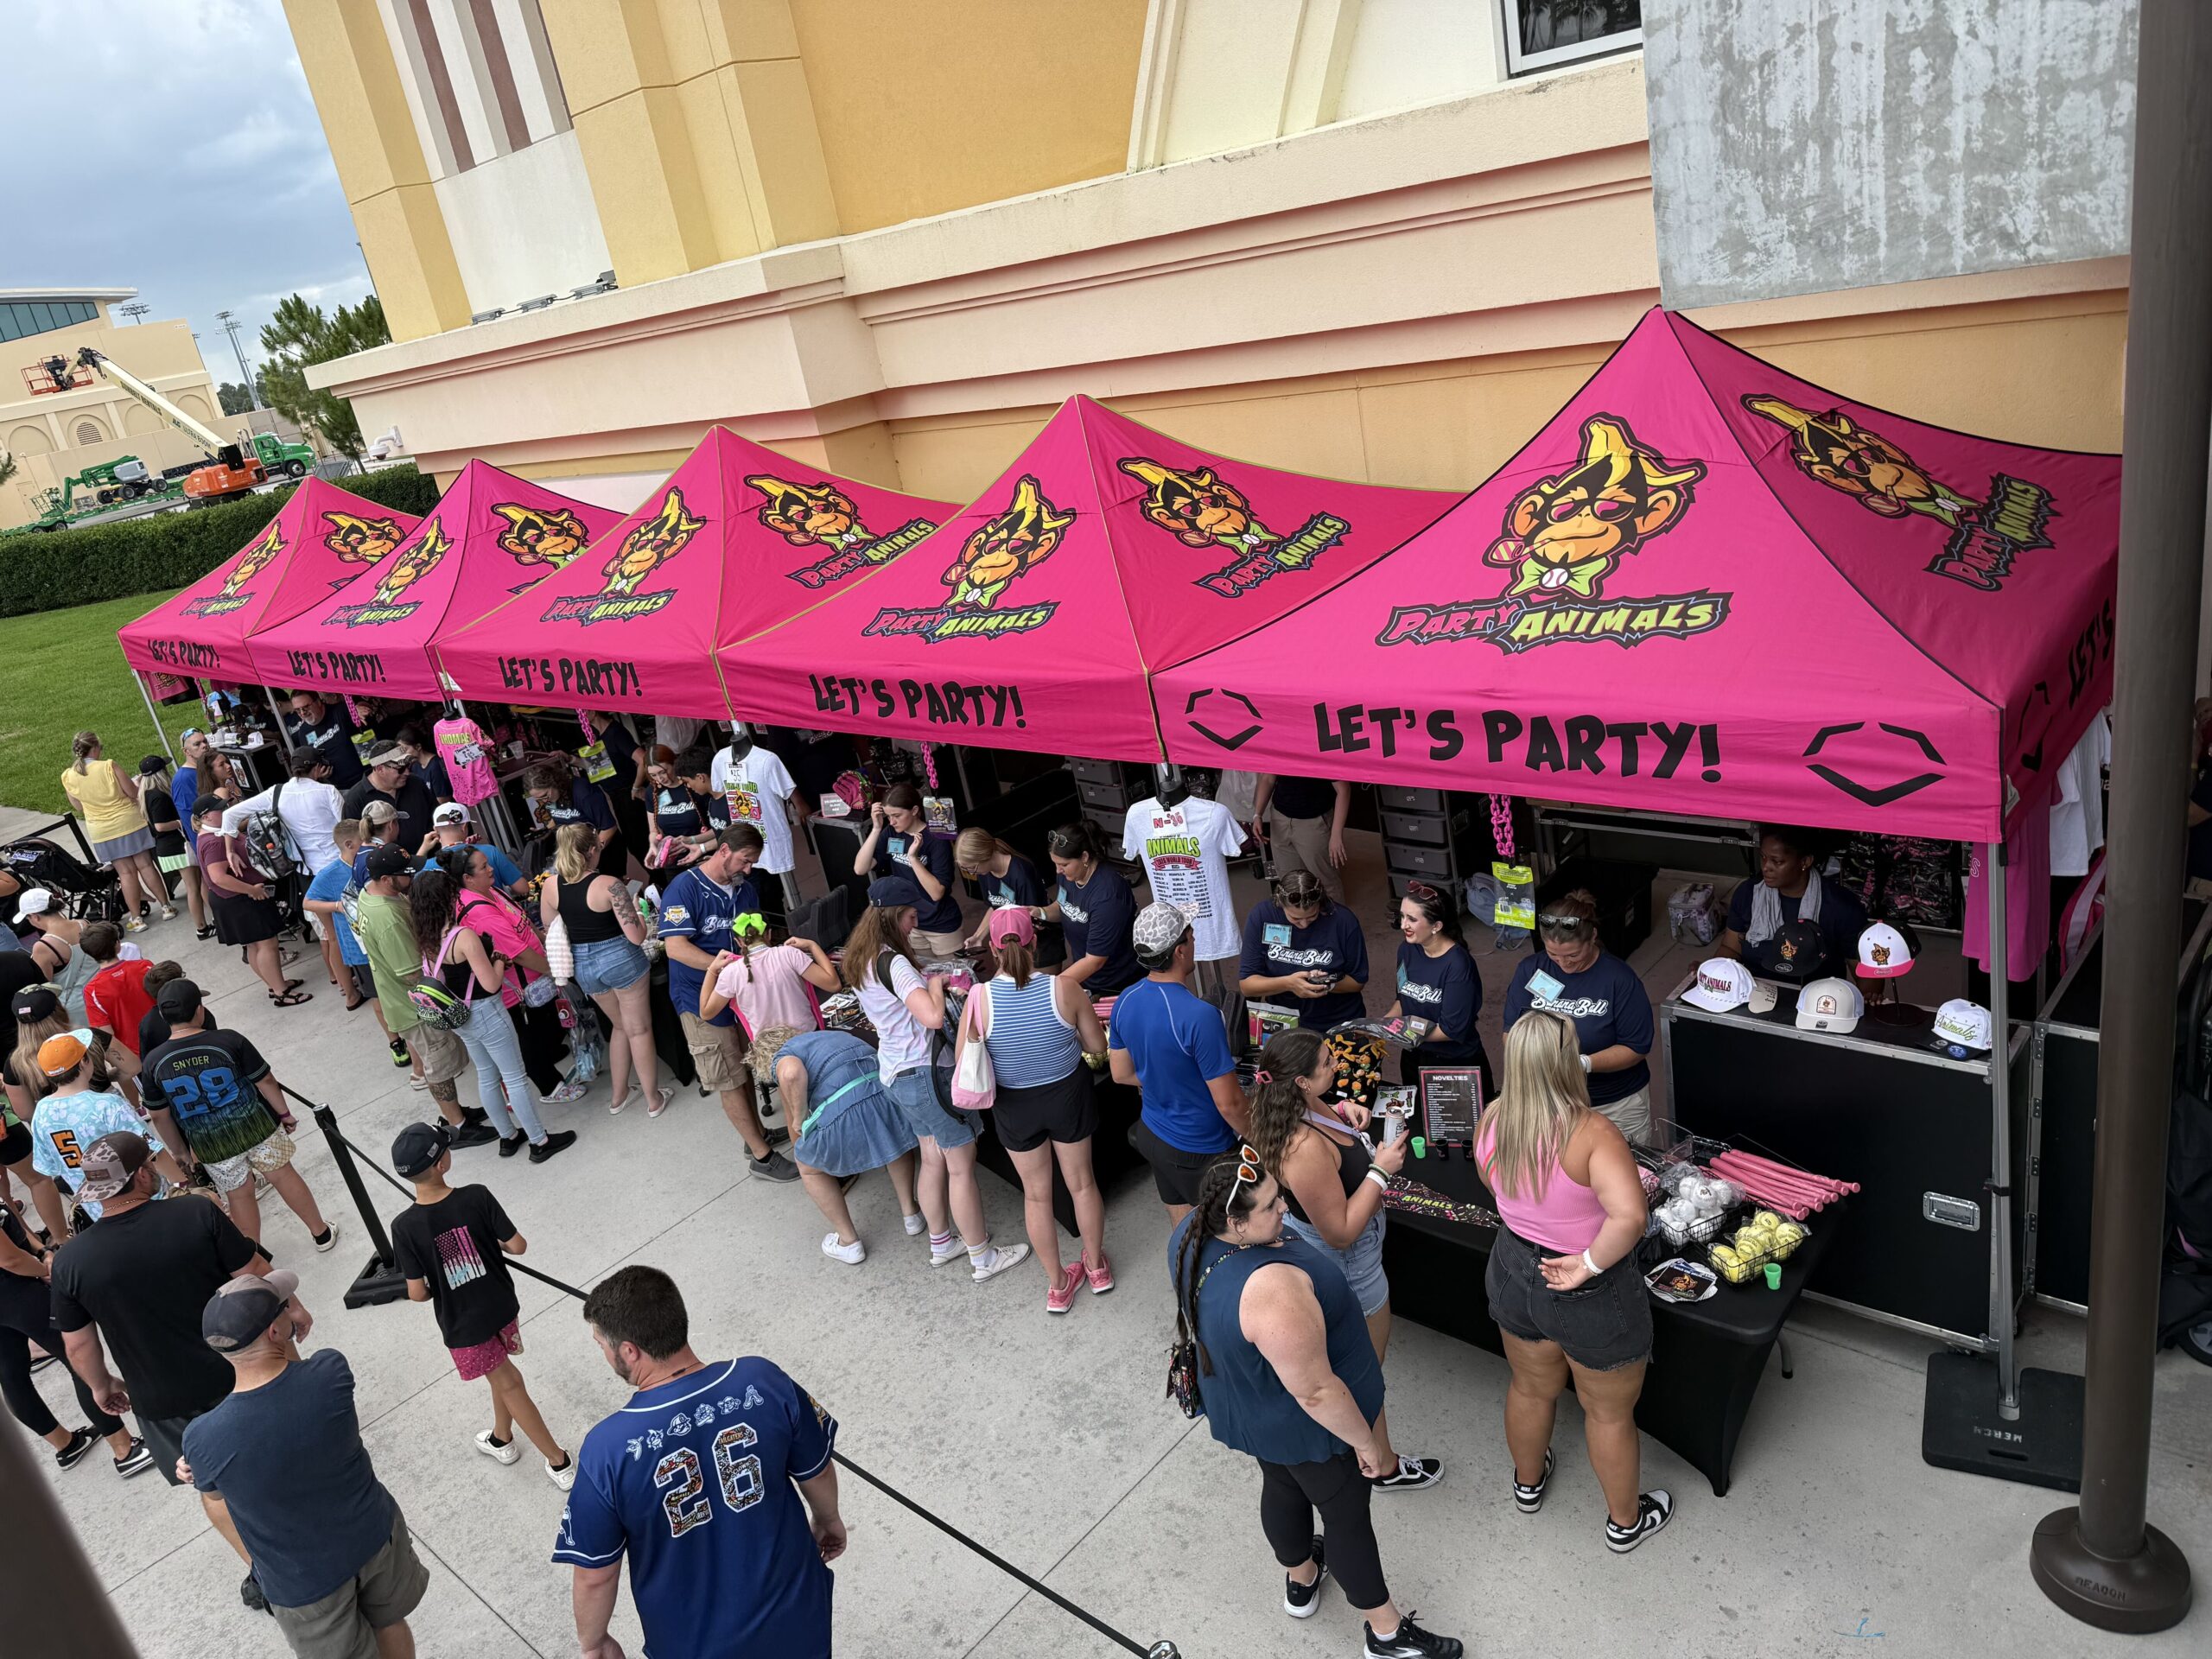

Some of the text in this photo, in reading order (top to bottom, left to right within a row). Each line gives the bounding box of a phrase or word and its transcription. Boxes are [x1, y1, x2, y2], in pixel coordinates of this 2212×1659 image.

[805, 520, 936, 586] PARTY ANIMALS
[1218, 516, 1344, 595] PARTY ANIMALS
[545, 594, 668, 620] PARTY ANIMALS
[1391, 599, 1714, 644] PARTY ANIMALS
[871, 607, 1049, 638] PARTY ANIMALS
[148, 639, 220, 669] LET'S PARTY!
[287, 650, 387, 683] LET'S PARTY!
[498, 656, 642, 697] LET'S PARTY!
[808, 673, 1027, 729] LET'S PARTY!
[1313, 702, 1722, 784] LET'S PARTY!
[1147, 836, 1201, 859] ANIMALS
[1268, 944, 1333, 967] Banana Ball
[1417, 984, 1442, 1003] Ball
[1707, 974, 1732, 992] ANIMALS
[1573, 998, 1608, 1017] Ball
[1936, 1014, 1978, 1041] Animals
[173, 1055, 210, 1071] SNYDER
[50, 1129, 84, 1169] 5
[1402, 1195, 1453, 1210] ANIMALS
[653, 1421, 765, 1538] 26
